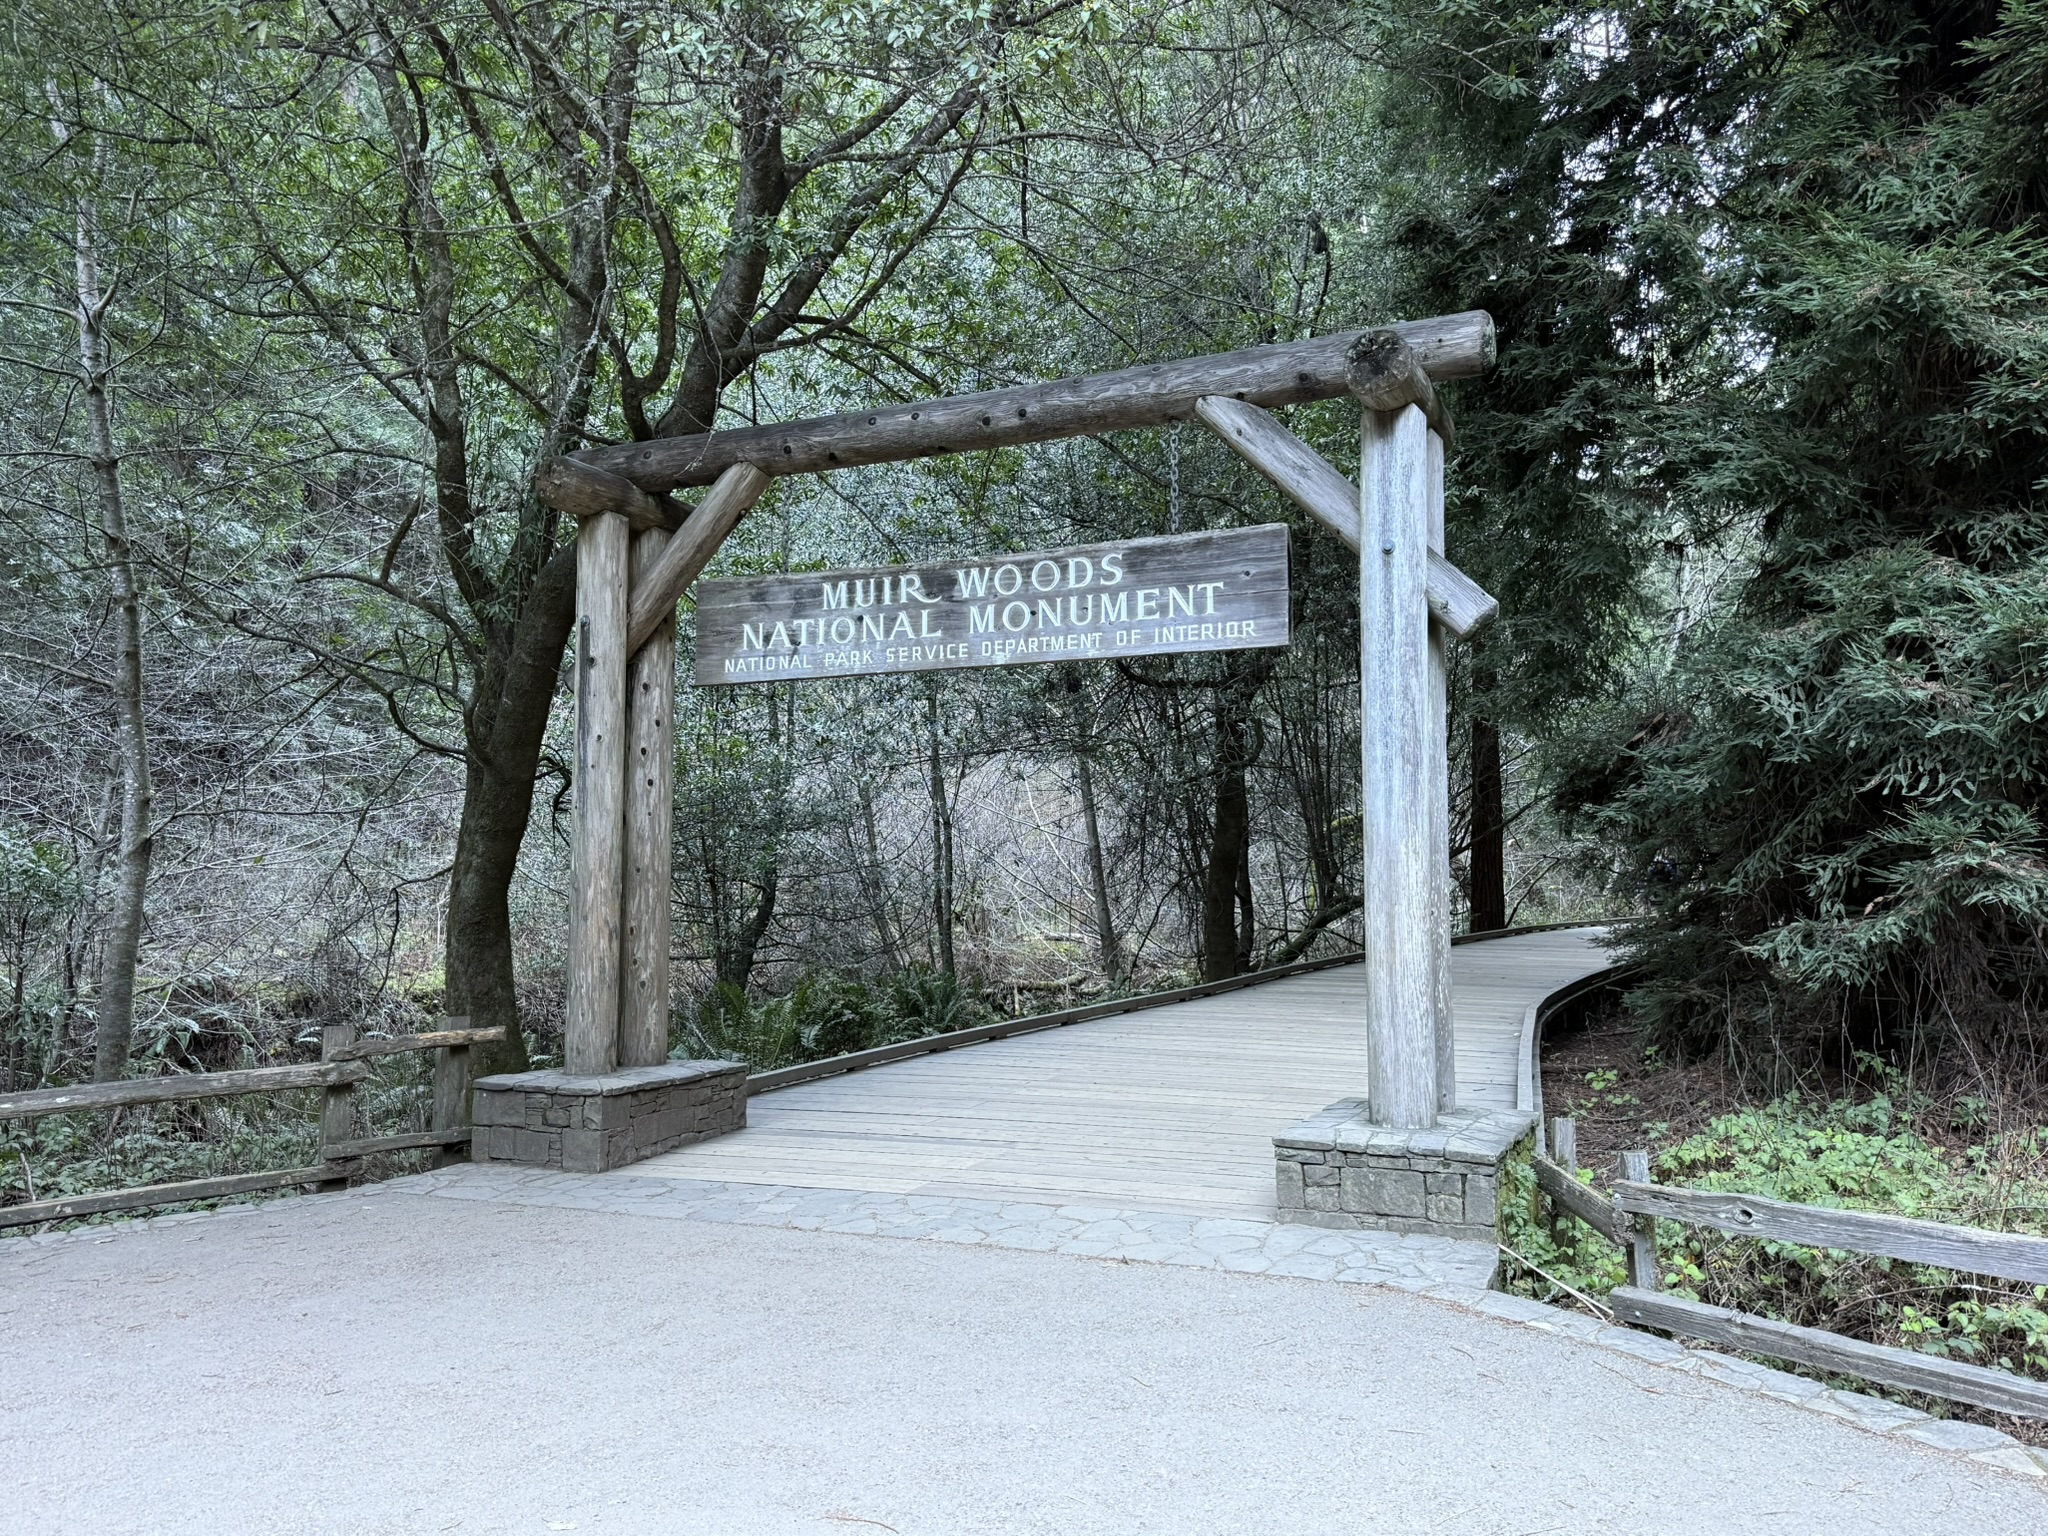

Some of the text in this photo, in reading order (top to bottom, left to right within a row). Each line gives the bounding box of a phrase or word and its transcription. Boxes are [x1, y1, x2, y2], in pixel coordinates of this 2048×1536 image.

[821, 552, 1124, 611] MUIR WOODS
[742, 581, 1225, 651] NATIONAL MONUMENT
[724, 619, 1257, 673] NATIONAL PARK SERVICE DEPARTMENT OF INTERIOR
